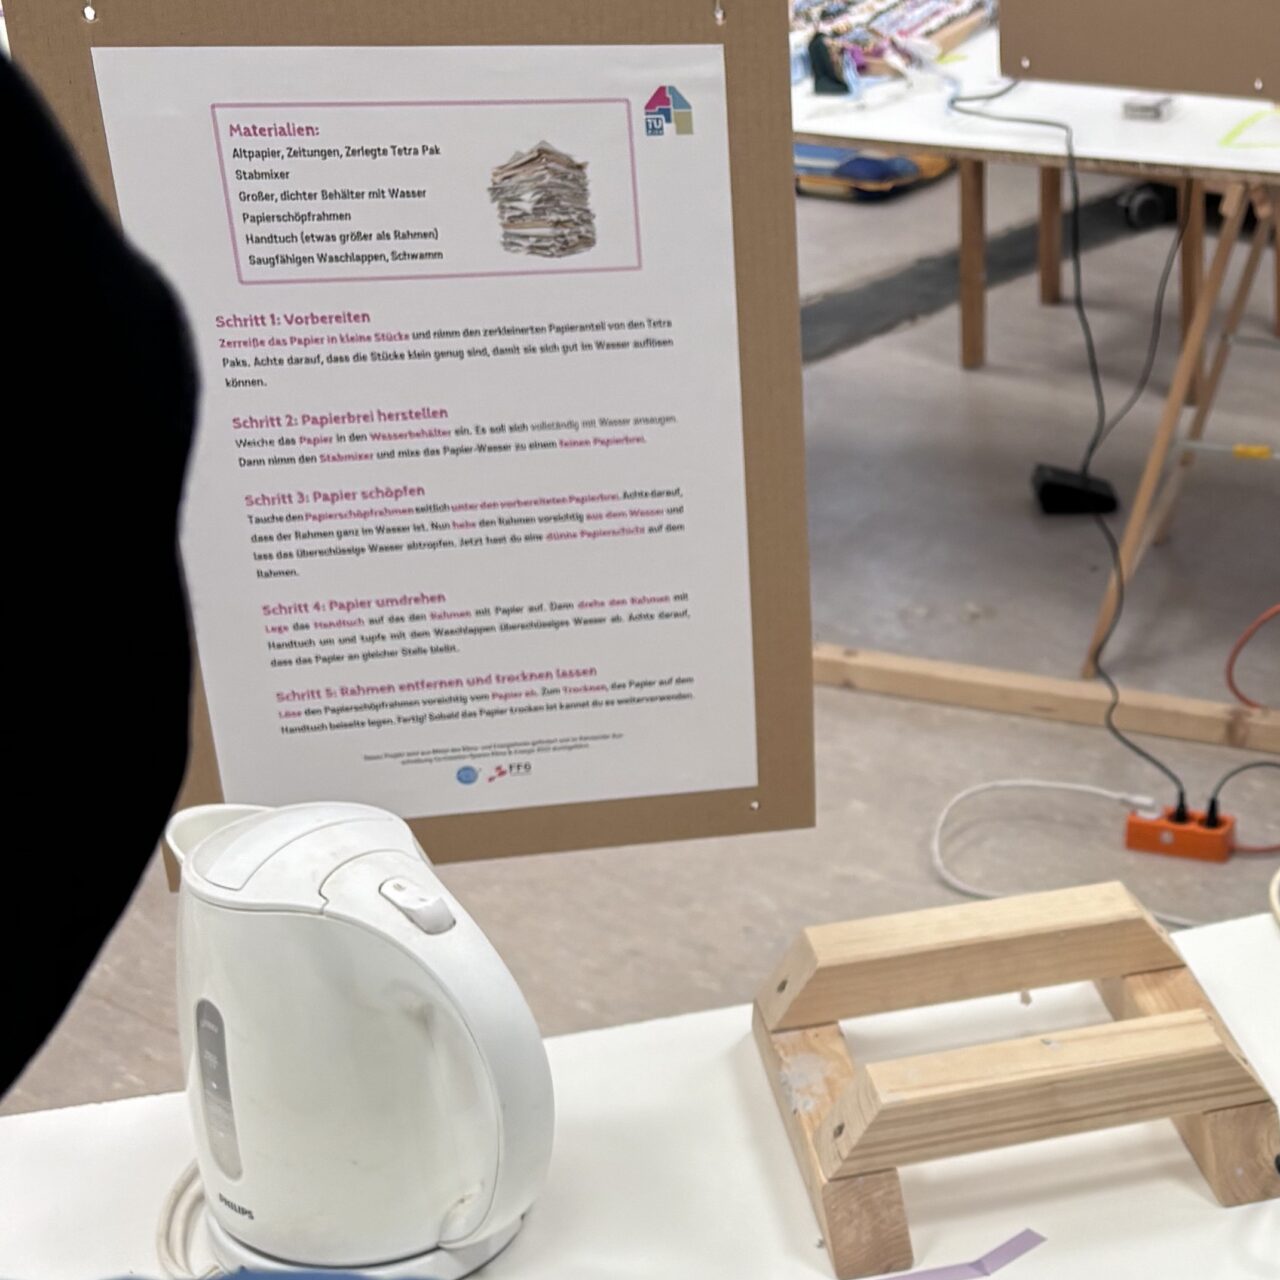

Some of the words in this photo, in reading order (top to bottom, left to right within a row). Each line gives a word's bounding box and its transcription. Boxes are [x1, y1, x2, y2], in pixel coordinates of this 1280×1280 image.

[229, 122, 319, 137] Materialien:
[232, 147, 284, 162] Altpapier,
[286, 146, 342, 161] Zeitungen,
[344, 145, 388, 160] Zerlegte
[390, 144, 418, 157] Tetra
[421, 144, 440, 156] Pak
[235, 168, 289, 181] Stabmixer
[238, 190, 277, 203] Großer,
[280, 189, 317, 201] dichter
[320, 188, 364, 200] Behälter
[368, 188, 385, 199] mit
[387, 187, 426, 199] Wasser
[242, 210, 351, 226] Papierschöpfrahmen
[245, 232, 298, 245] Handtuch
[300, 230, 336, 244] (etwas
[339, 230, 372, 245] größer
[376, 230, 390, 241] als
[393, 227, 438, 240] Rahmen)
[248, 253, 314, 268] Saugfähigen
[316, 251, 388, 265] Waschlappen,
[390, 250, 443, 262] Schwamm
[215, 313, 266, 328] Schritt
[269, 312, 280, 326] 1:
[283, 311, 370, 326] Vorbereiten
[218, 337, 265, 349] Zerreiße
[267, 336, 287, 347] das
[289, 335, 324, 348] Papier
[326, 335, 337, 344] in
[339, 332, 372, 344] kleine
[373, 331, 409, 342] Stücke
[411, 329, 431, 340] und
[432, 328, 460, 339] nimm
[462, 328, 480, 338] den
[607, 321, 625, 331] von
[626, 319, 645, 330] den
[646, 317, 672, 329] Tetra
[222, 357, 250, 368] Paks.
[253, 355, 284, 367] Achte
[286, 353, 323, 366] darauf,
[326, 353, 350, 364] dass
[352, 351, 367, 363] die
[370, 349, 405, 362] Stücke
[407, 349, 431, 360] klein
[433, 349, 464, 362] genug
[466, 346, 489, 358] sind,
[539, 342, 559, 354] sich
[561, 342, 578, 355] gut
[580, 341, 592, 351] im
[594, 340, 629, 350] Wasser
[224, 377, 268, 388] können.
[232, 415, 281, 429] Schritt
[285, 413, 297, 427] 2:
[301, 410, 374, 429] Papierbrei
[376, 407, 448, 422] herstellen
[244, 492, 292, 507] Schritt
[296, 490, 309, 504] 3:
[312, 489, 356, 505] Papier
[360, 484, 425, 501] schöpfen
[261, 602, 308, 616] Schritt
[312, 601, 325, 612] 4:
[328, 598, 371, 614] Papier
[374, 592, 445, 608] umdrehen
